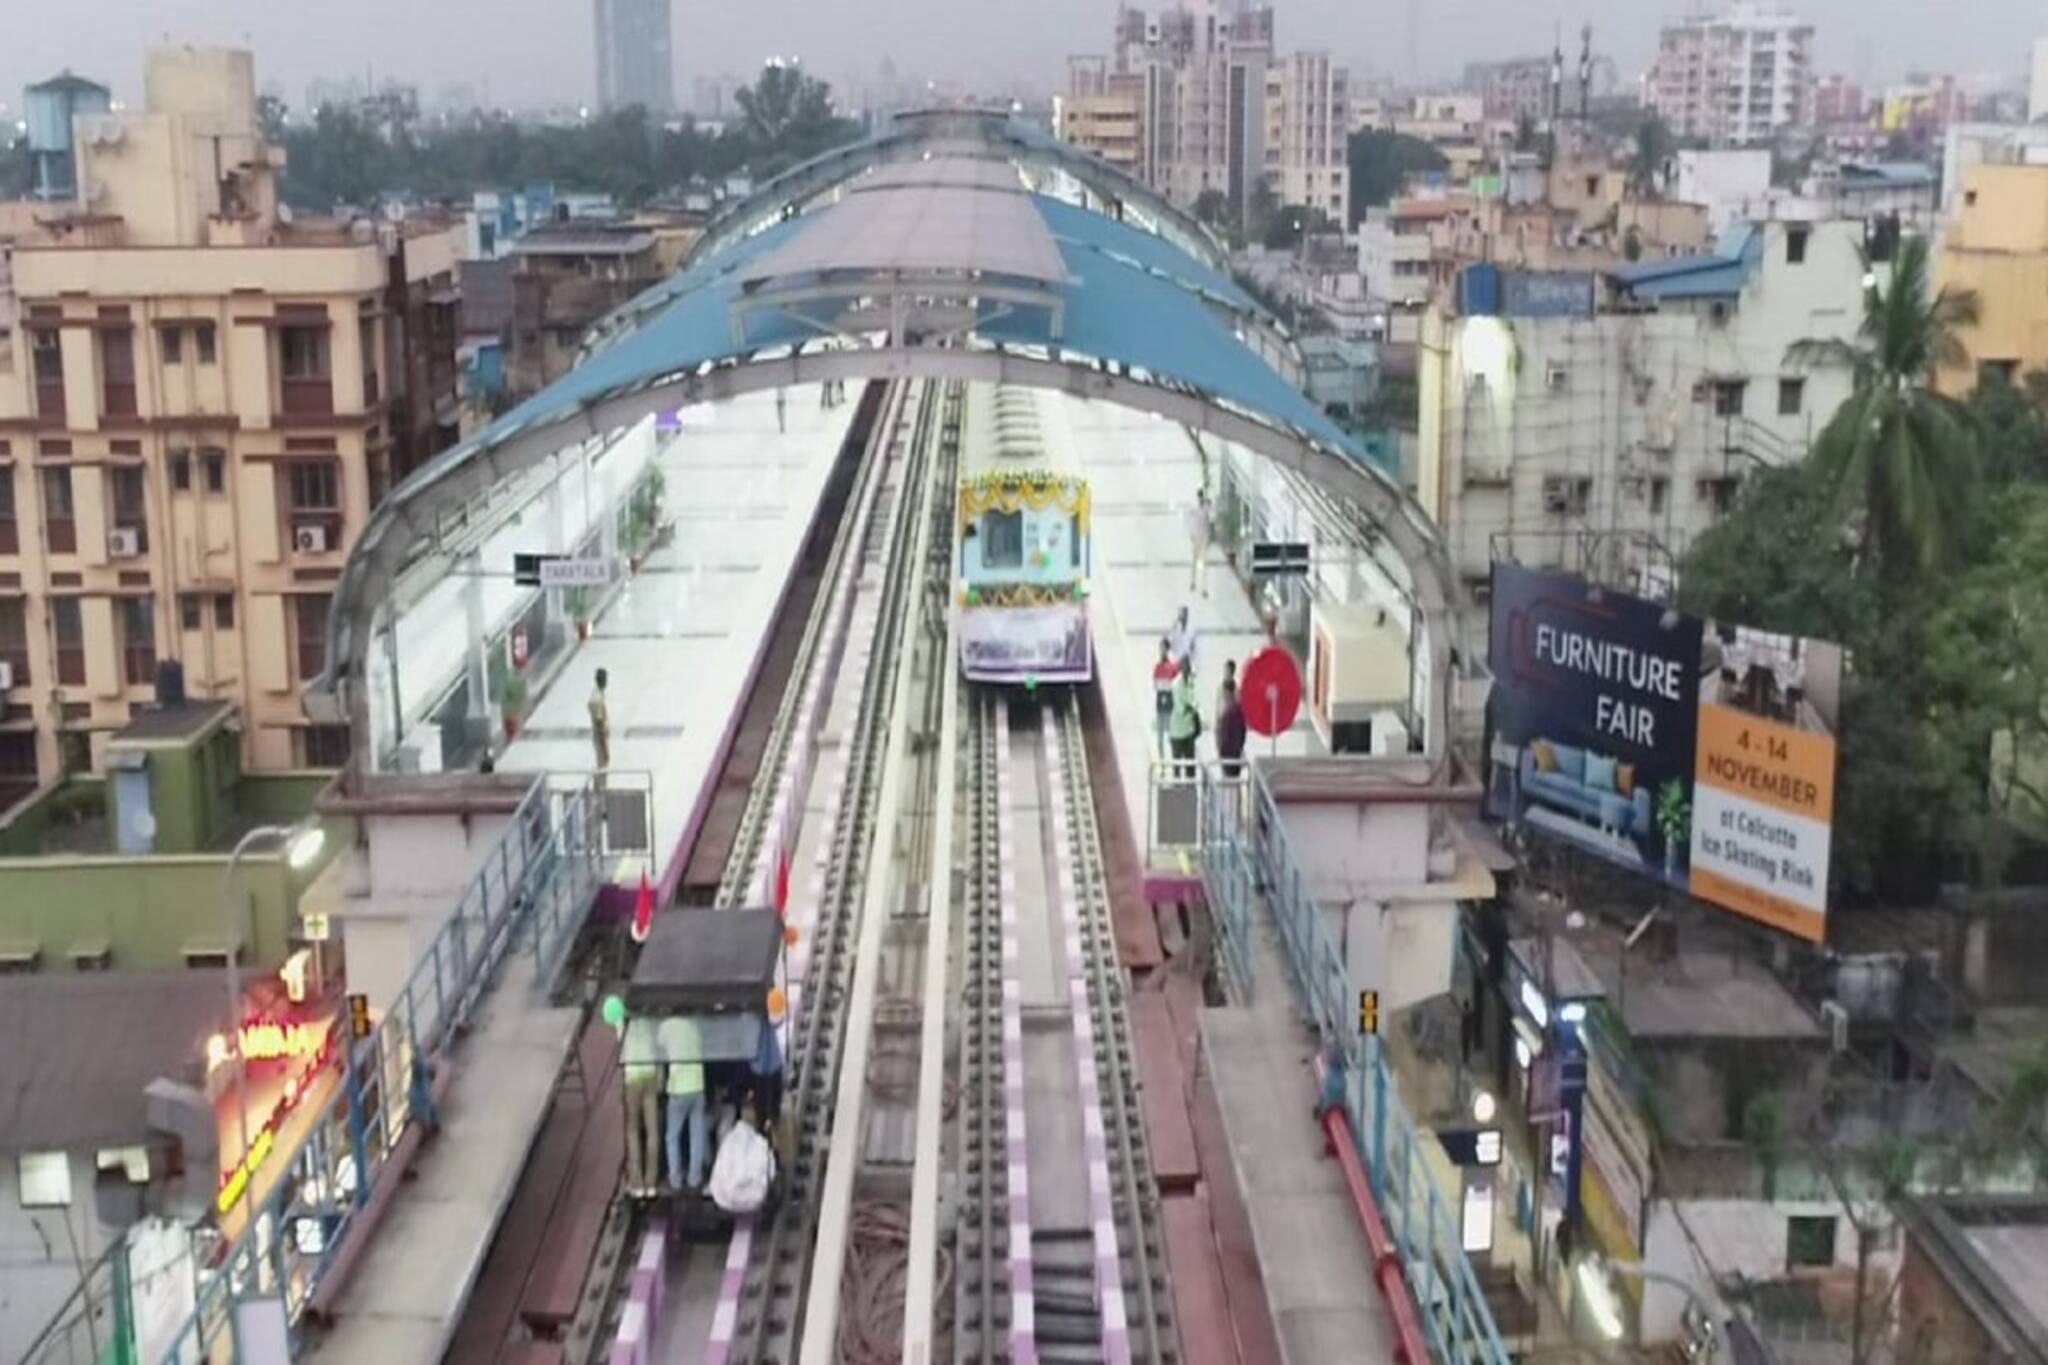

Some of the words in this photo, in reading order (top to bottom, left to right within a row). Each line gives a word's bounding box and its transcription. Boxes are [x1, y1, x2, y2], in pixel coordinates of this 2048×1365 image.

[1536, 624, 1683, 700] FURNITURE
[1596, 695, 1654, 748] FAIR
[1737, 729, 1750, 750] 4
[1768, 735, 1788, 762] 14
[1707, 753, 1817, 806] NOVEMBER
[1720, 810, 1734, 830] at
[1738, 811, 1797, 851] Calcutta
[1701, 830, 1721, 856] Ice
[1725, 839, 1777, 883] Skating
[1781, 858, 1814, 889] Rink
